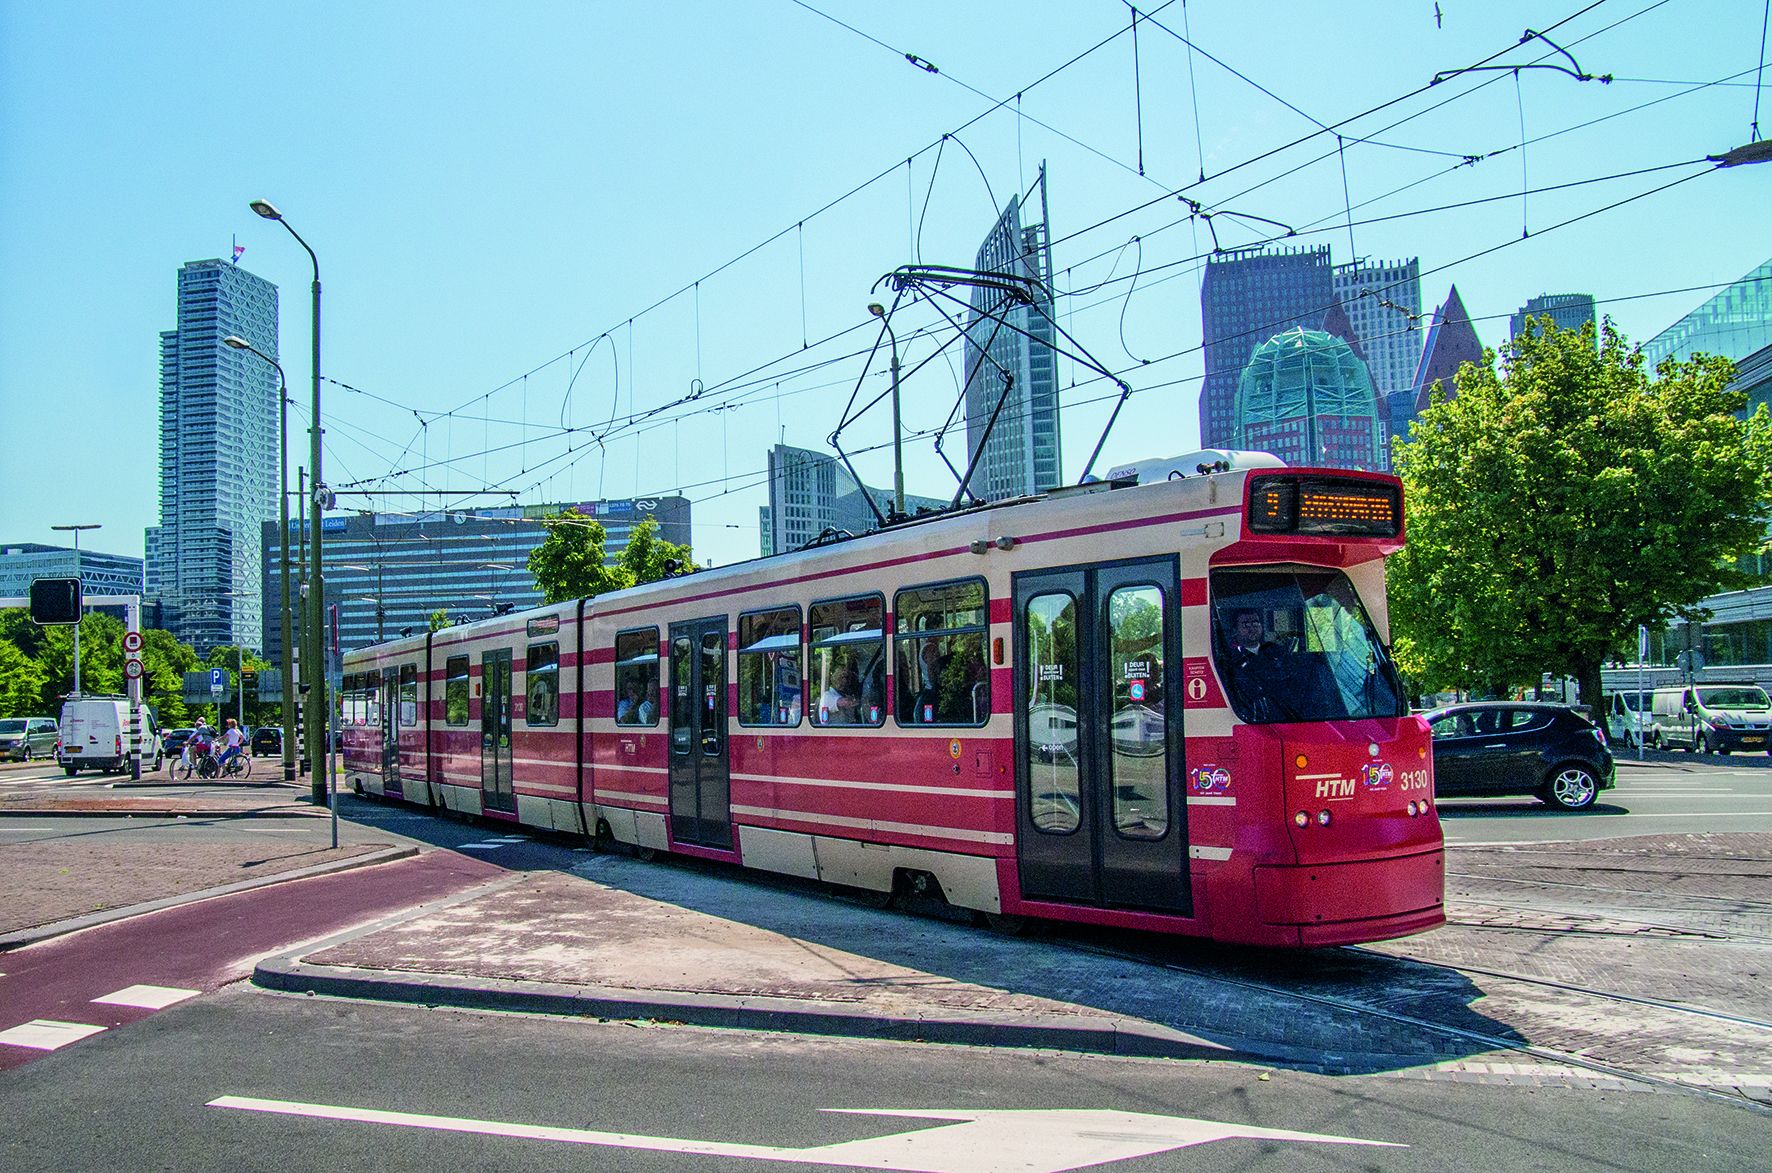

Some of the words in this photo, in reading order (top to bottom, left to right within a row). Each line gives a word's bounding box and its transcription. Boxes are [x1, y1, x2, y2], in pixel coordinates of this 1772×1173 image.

[213, 670, 220, 684] P
[1315, 779, 1356, 798] HTM
[1400, 769, 1428, 791] 3130
